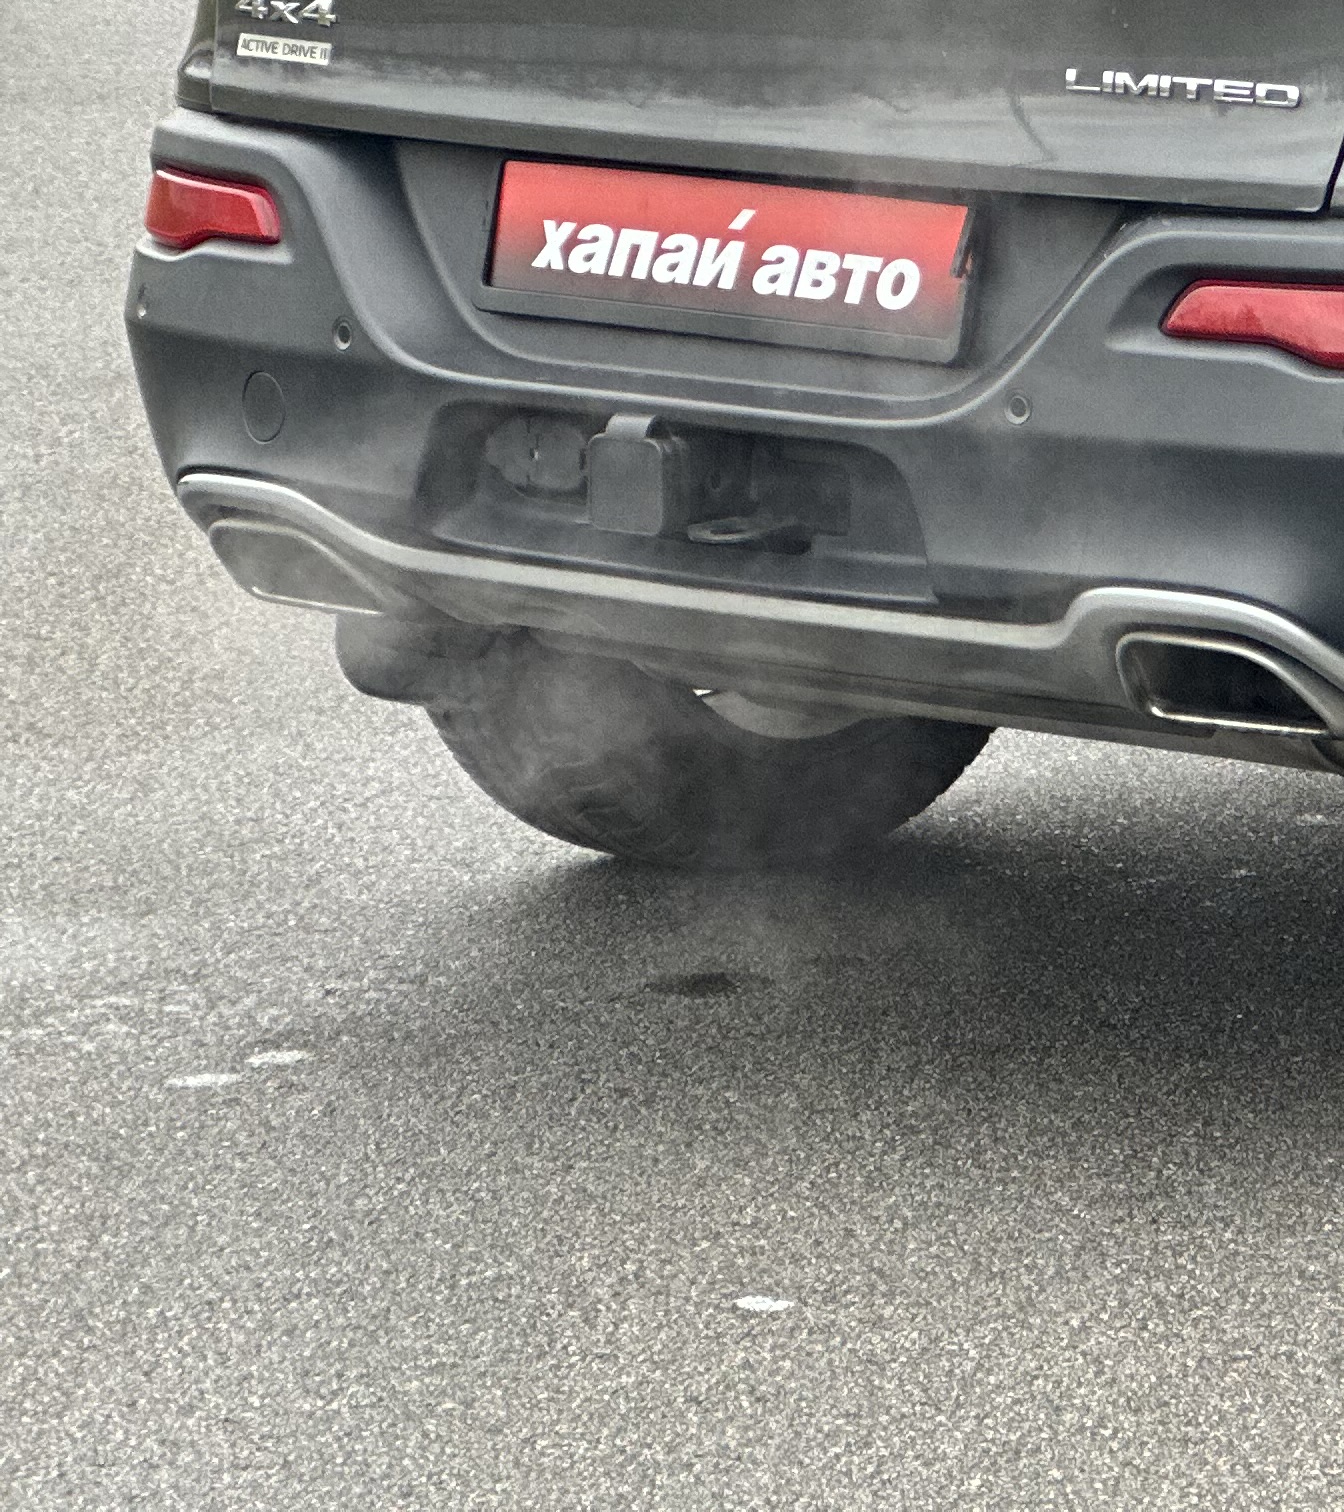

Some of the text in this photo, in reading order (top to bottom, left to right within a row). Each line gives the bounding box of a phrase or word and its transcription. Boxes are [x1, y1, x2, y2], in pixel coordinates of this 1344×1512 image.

[241, 37, 279, 55] ACTIVE
[282, 42, 317, 59] DRIVE
[1065, 67, 1300, 109] LIMITED
[752, 244, 922, 311] авто
